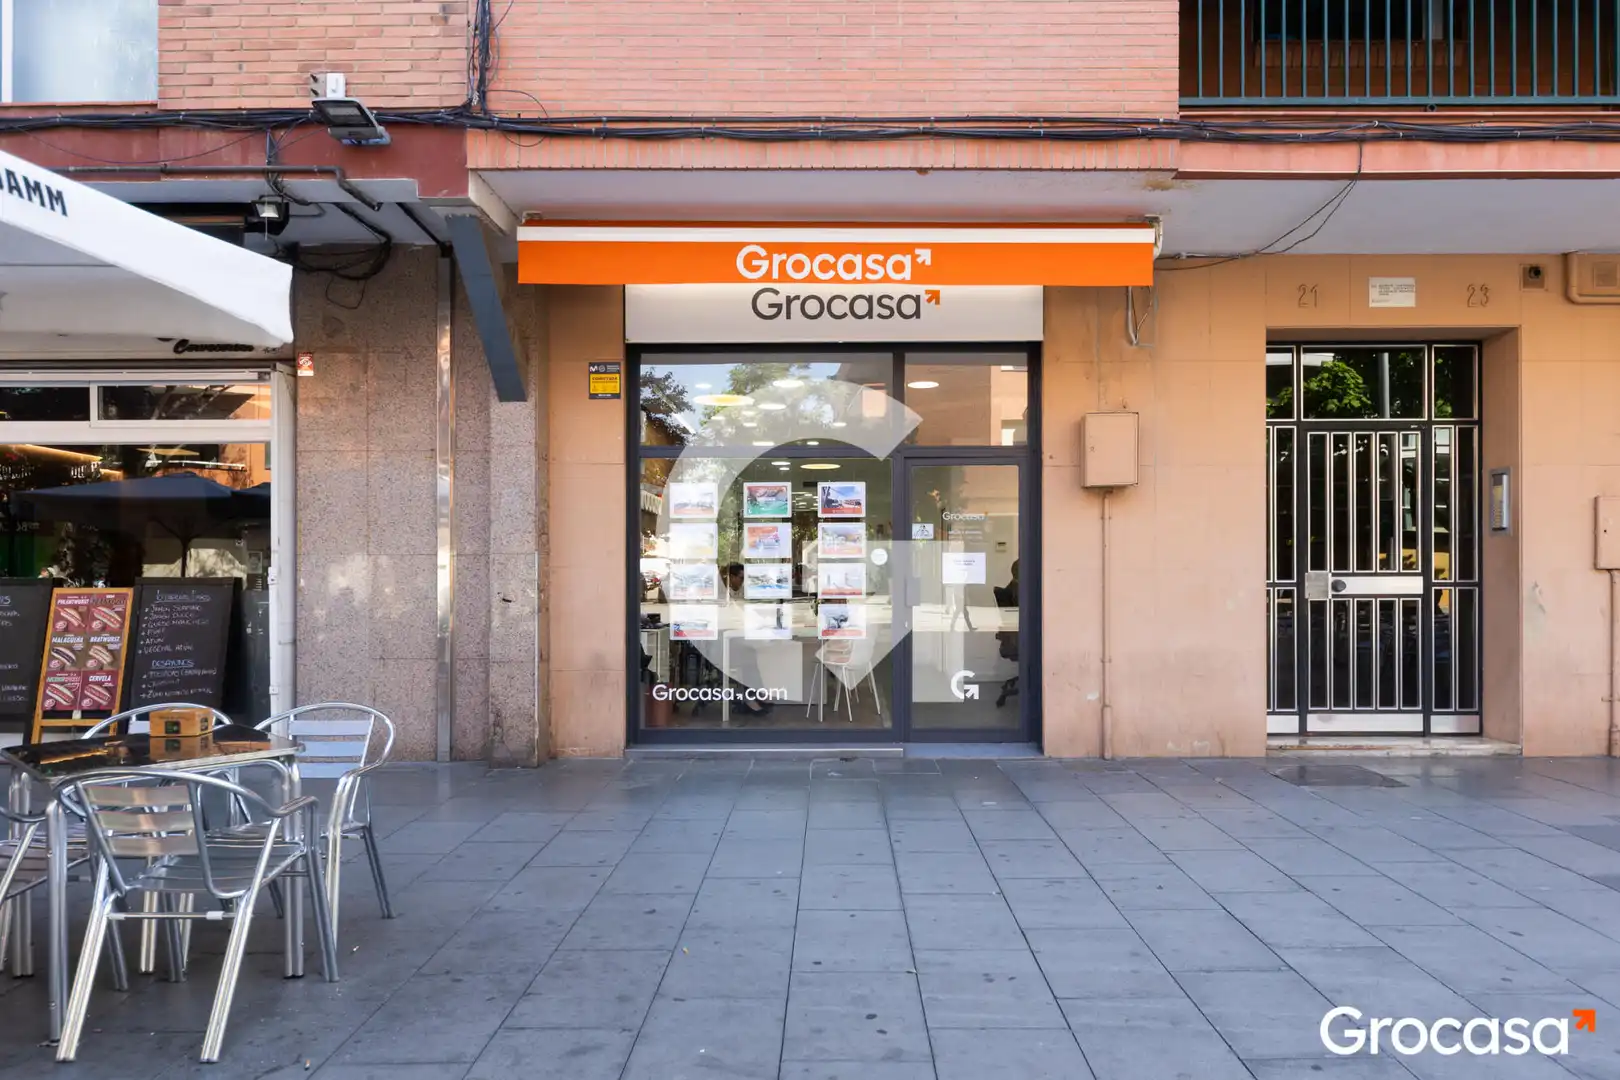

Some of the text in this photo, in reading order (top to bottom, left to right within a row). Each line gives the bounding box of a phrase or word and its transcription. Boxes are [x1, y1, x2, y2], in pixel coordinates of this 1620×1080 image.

[736, 244, 912, 280] Grocasa
[751, 287, 921, 320] Grocasa
[1297, 283, 1319, 308] 21
[1466, 283, 1490, 308] 23
